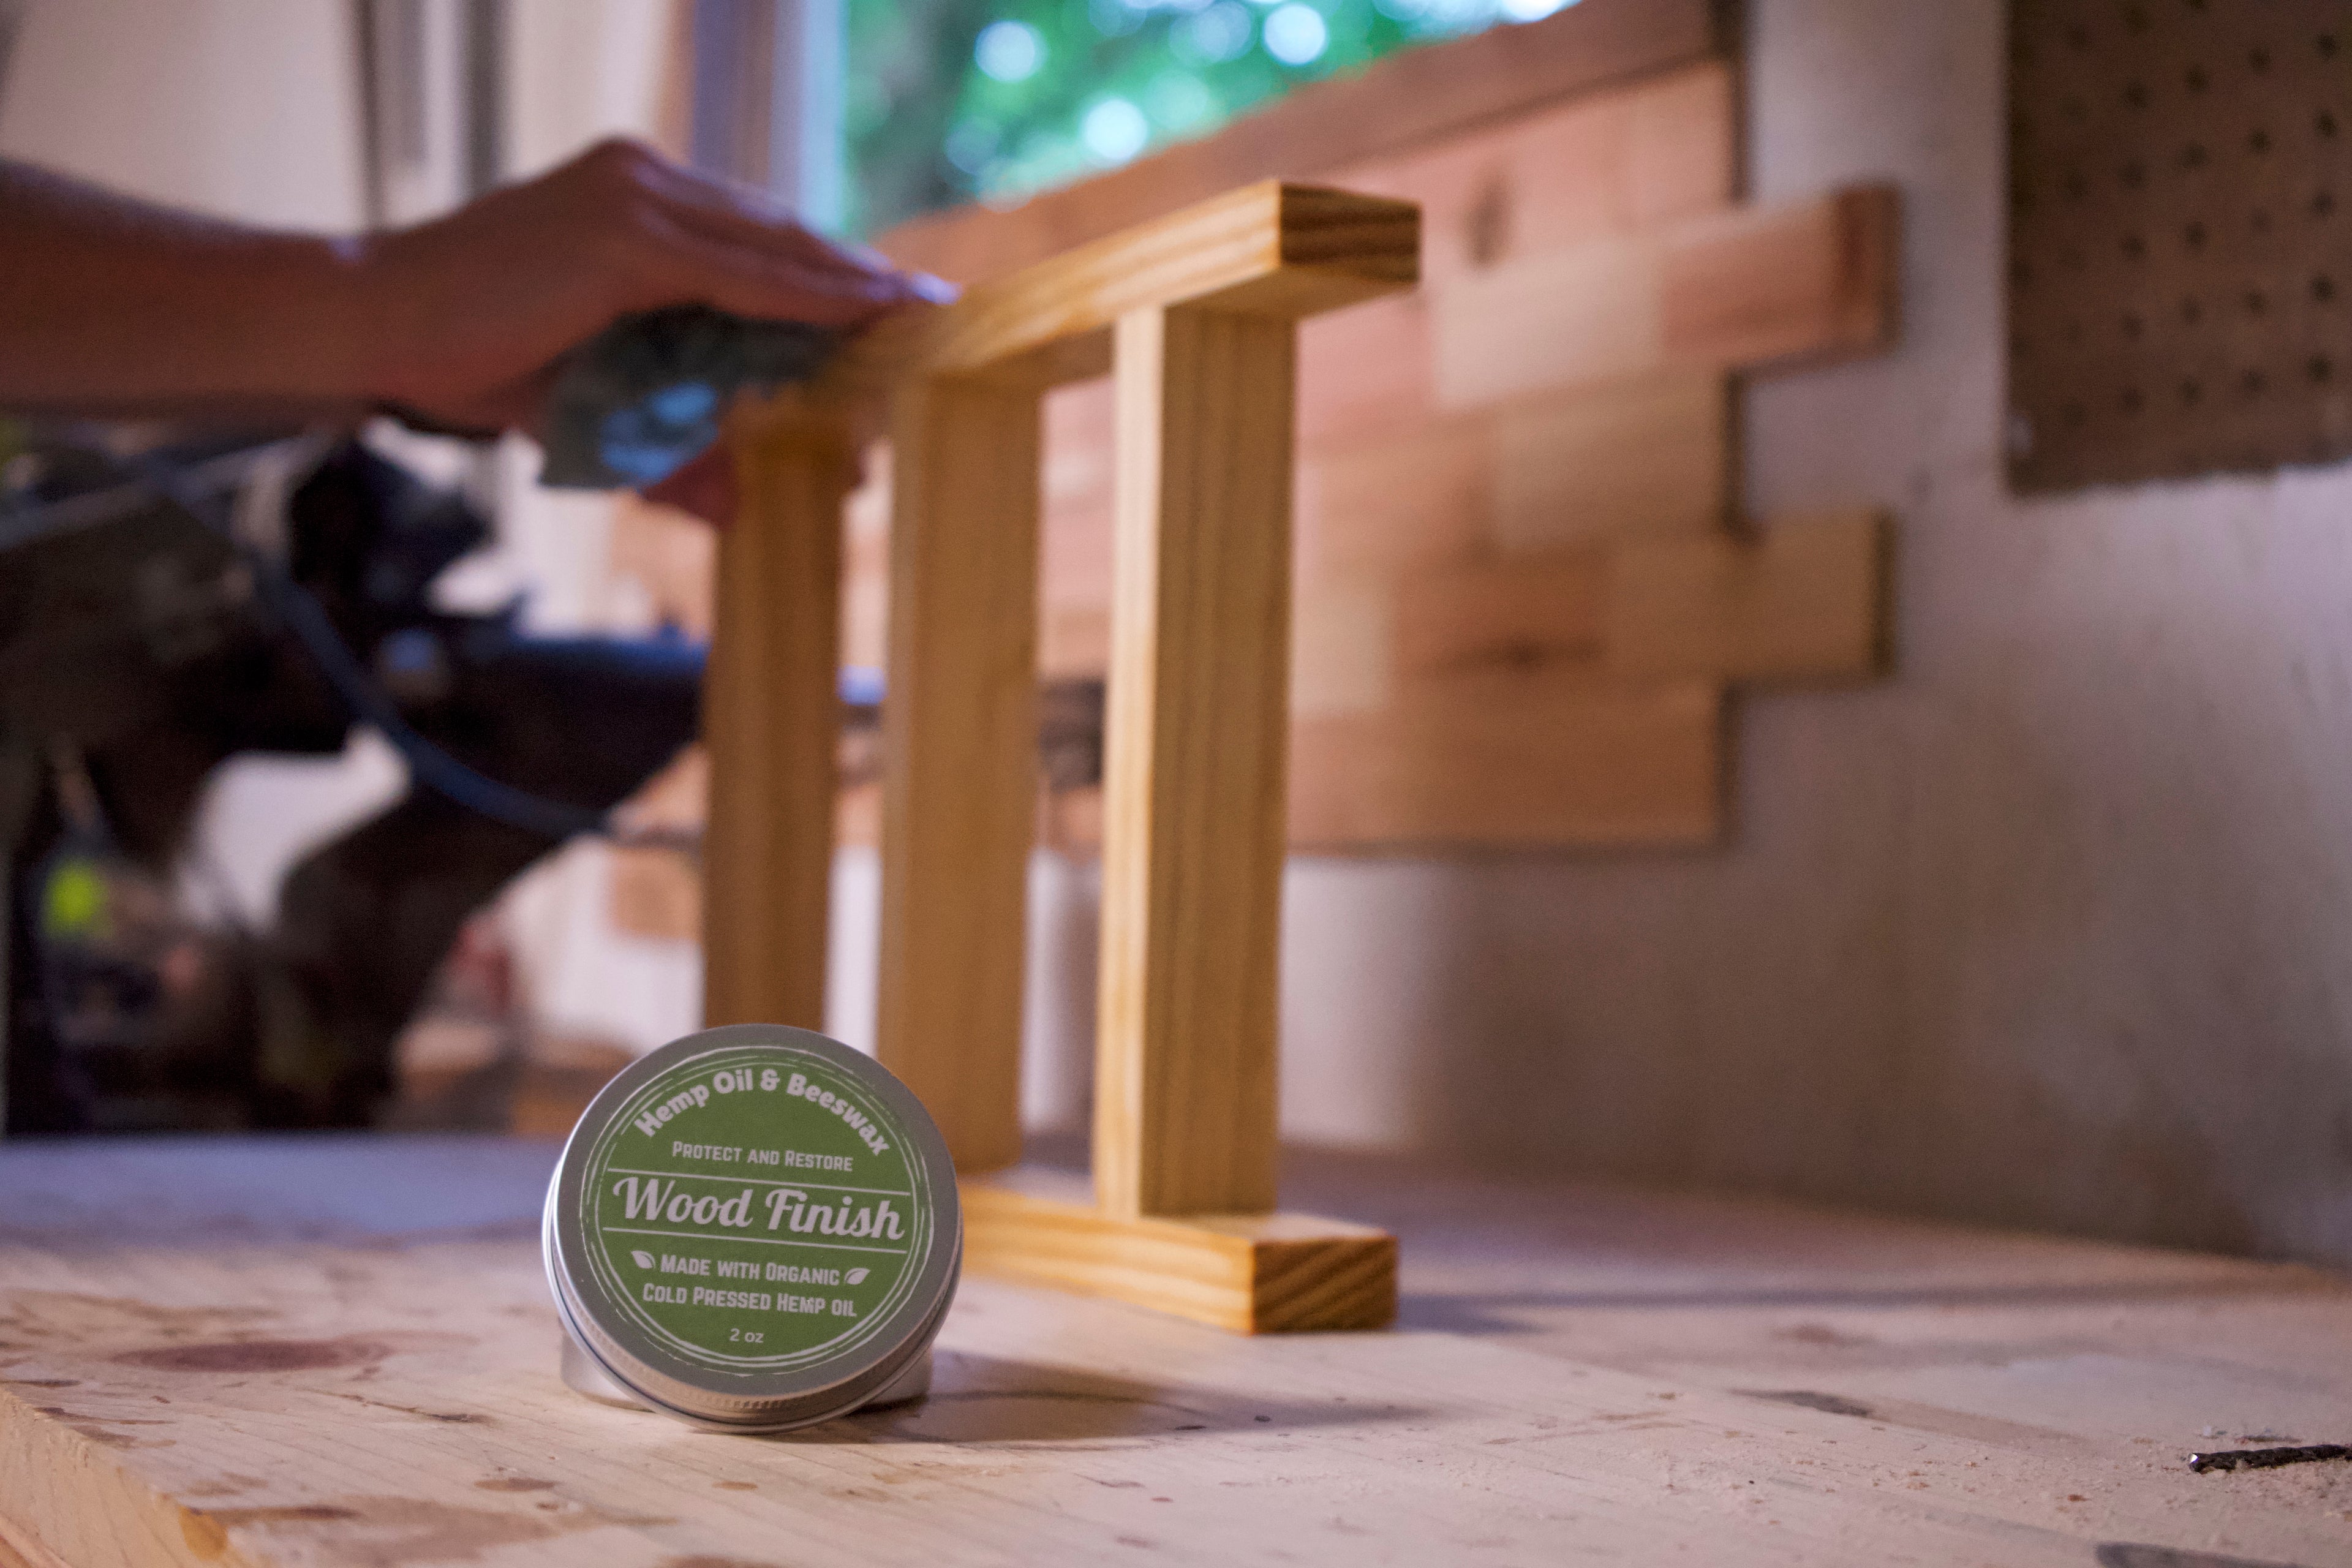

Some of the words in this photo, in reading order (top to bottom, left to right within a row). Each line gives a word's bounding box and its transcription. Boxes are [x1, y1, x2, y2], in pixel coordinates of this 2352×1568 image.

[634, 1084, 710, 1137] Hemp
[712, 1068, 754, 1095] Oil
[759, 1068, 781, 1092] &
[786, 1072, 890, 1156] Beeswax
[612, 1176, 753, 1227] Wood
[764, 1188, 905, 1240] Finish
[729, 1327, 740, 1342] 2
[744, 1332, 764, 1344] oz
